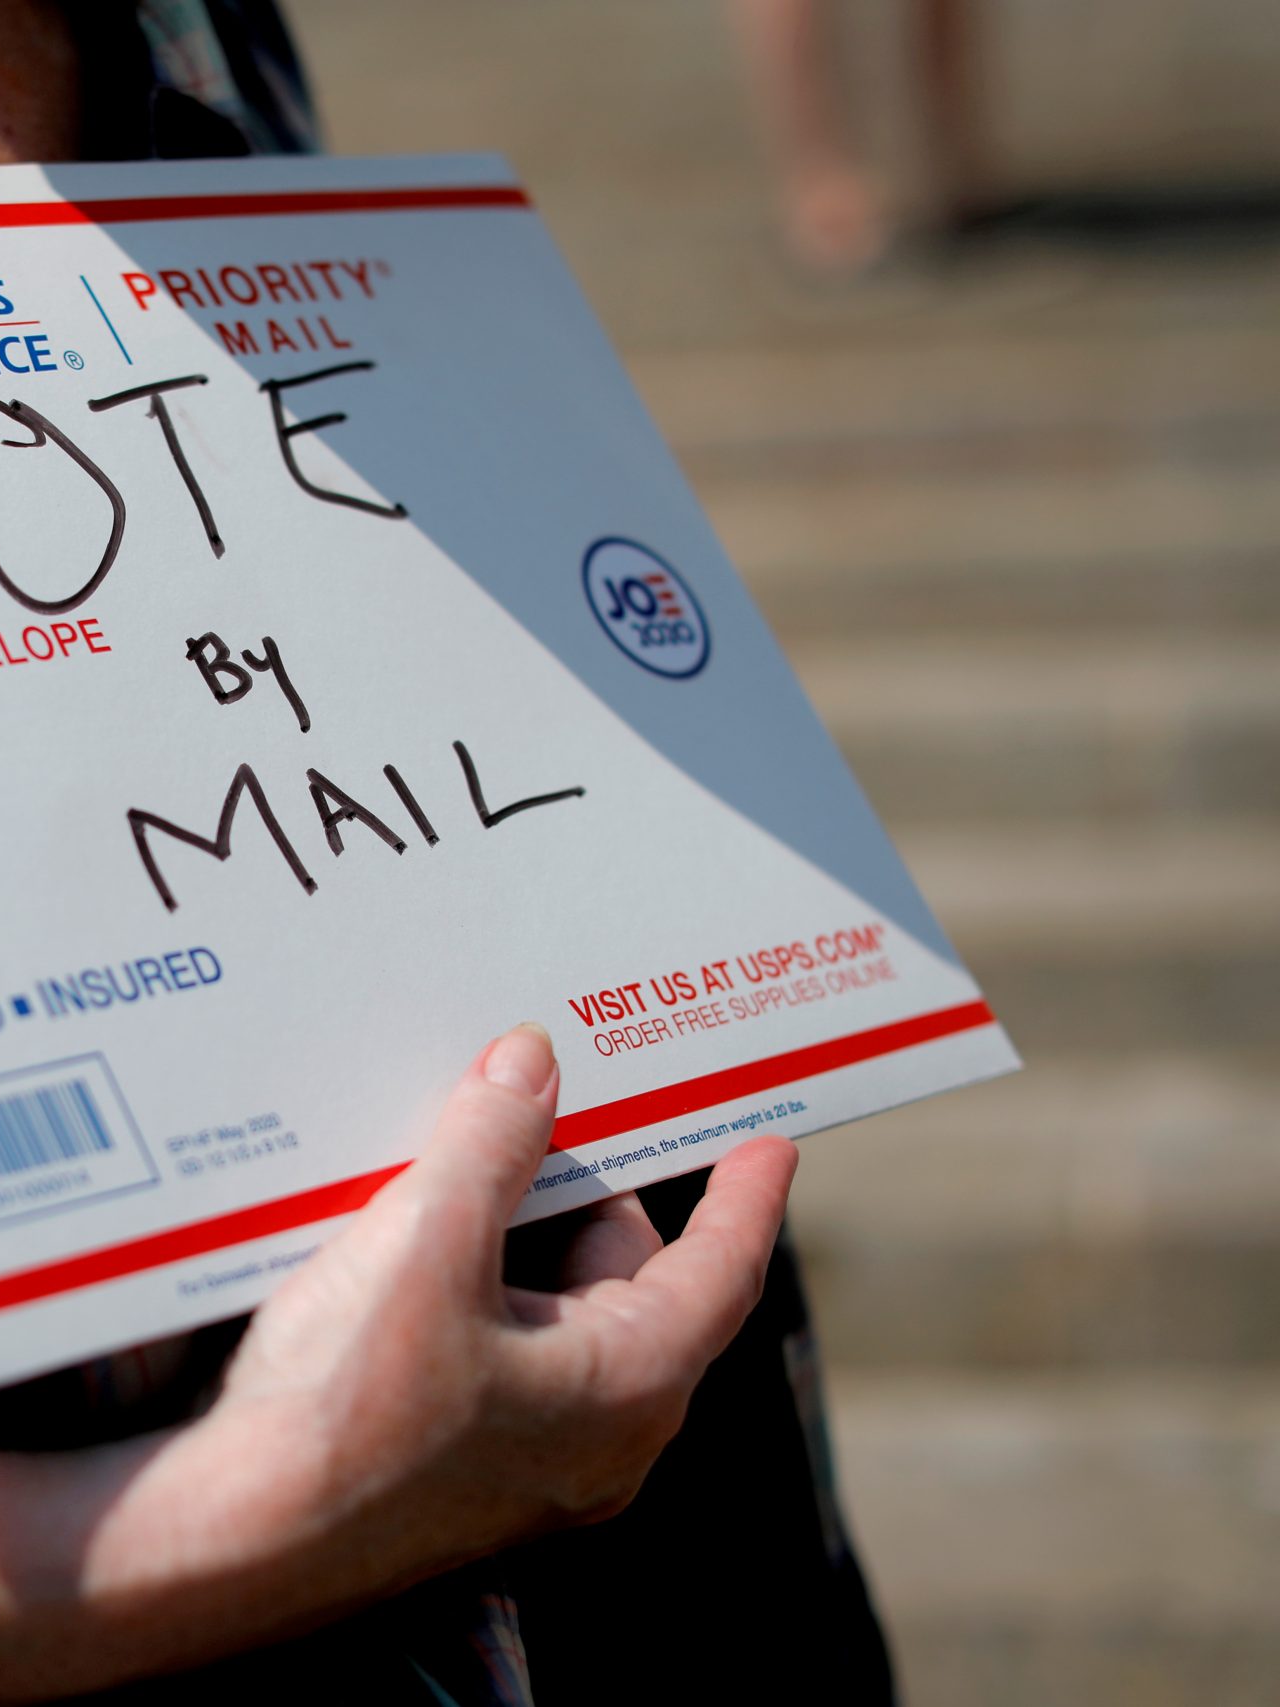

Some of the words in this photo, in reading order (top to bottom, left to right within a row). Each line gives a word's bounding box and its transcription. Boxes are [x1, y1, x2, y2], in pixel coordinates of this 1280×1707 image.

[120, 258, 376, 311] PRIORITY
[214, 315, 353, 357] MAIL
[604, 574, 684, 620] JOE
[127, 740, 587, 914] MAIL
[35, 946, 223, 1020] INSURED
[568, 982, 647, 1027] VISIT
[650, 971, 697, 1006] US
[700, 960, 734, 995] AT
[593, 1016, 673, 1057] ORDER
[671, 1000, 729, 1037] FREE
[728, 974, 825, 1021] SUPPLIES
[823, 955, 899, 996] ONLINE
[532, 1160, 601, 1192] international
[601, 1144, 661, 1171] shipments,
[660, 1137, 679, 1153] the
[678, 1122, 730, 1148] maximum
[729, 1112, 764, 1133] weight
[763, 1106, 775, 1121] is
[773, 1102, 788, 1118] 20
